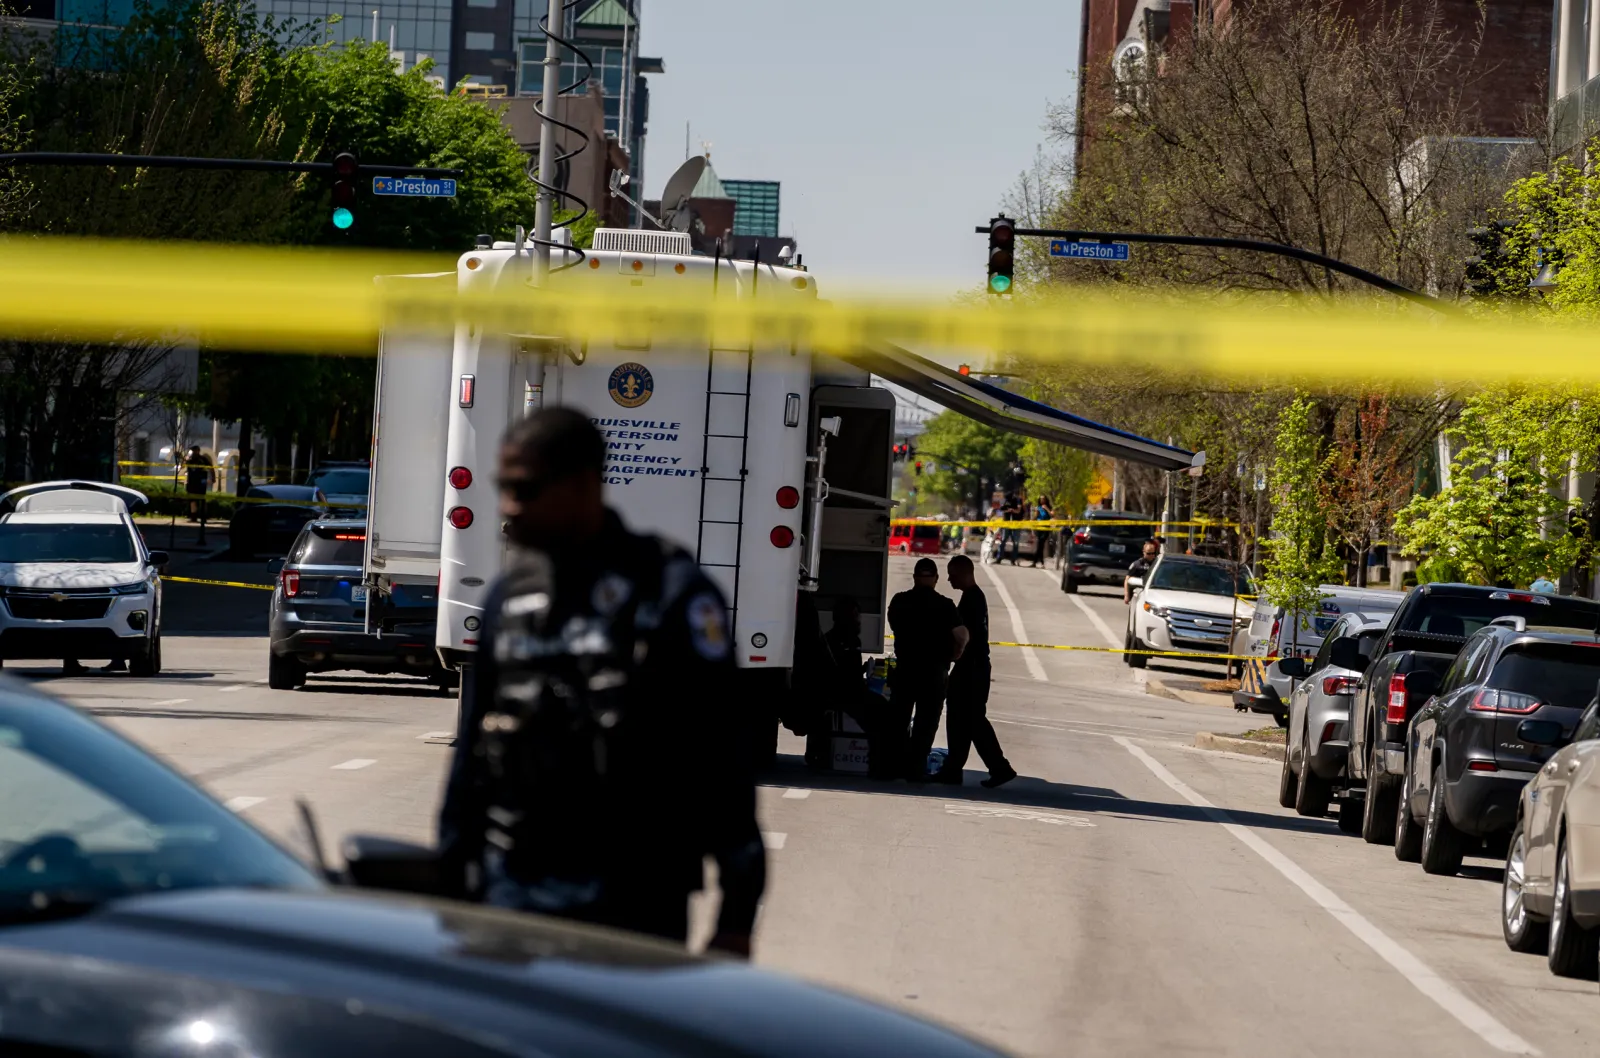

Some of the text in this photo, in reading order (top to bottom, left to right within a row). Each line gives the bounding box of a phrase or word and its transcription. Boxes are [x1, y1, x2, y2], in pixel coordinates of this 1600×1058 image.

[387, 180, 451, 194] S Preston St
[1063, 243, 1124, 257] N Preston St
[611, 363, 652, 382] LOUISVILLE
[590, 417, 681, 430] OUISVILLE
[606, 453, 682, 465] RGENCY
